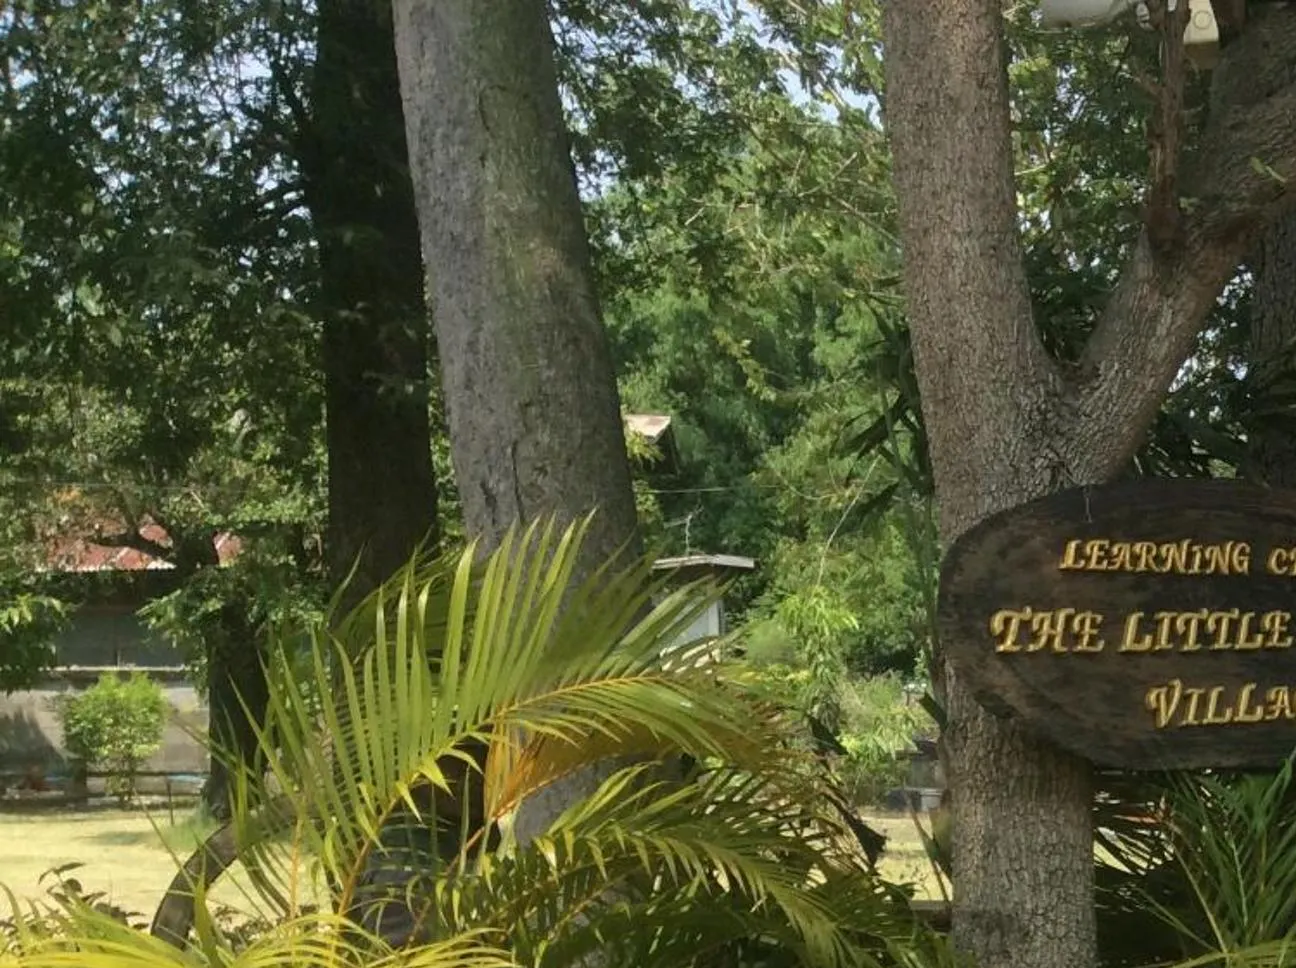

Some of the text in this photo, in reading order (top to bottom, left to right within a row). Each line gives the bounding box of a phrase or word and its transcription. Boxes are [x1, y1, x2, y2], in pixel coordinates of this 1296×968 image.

[1059, 538, 1251, 576] LEARNING
[990, 606, 1105, 653] THE
[1118, 609, 1294, 653] LITTLE
